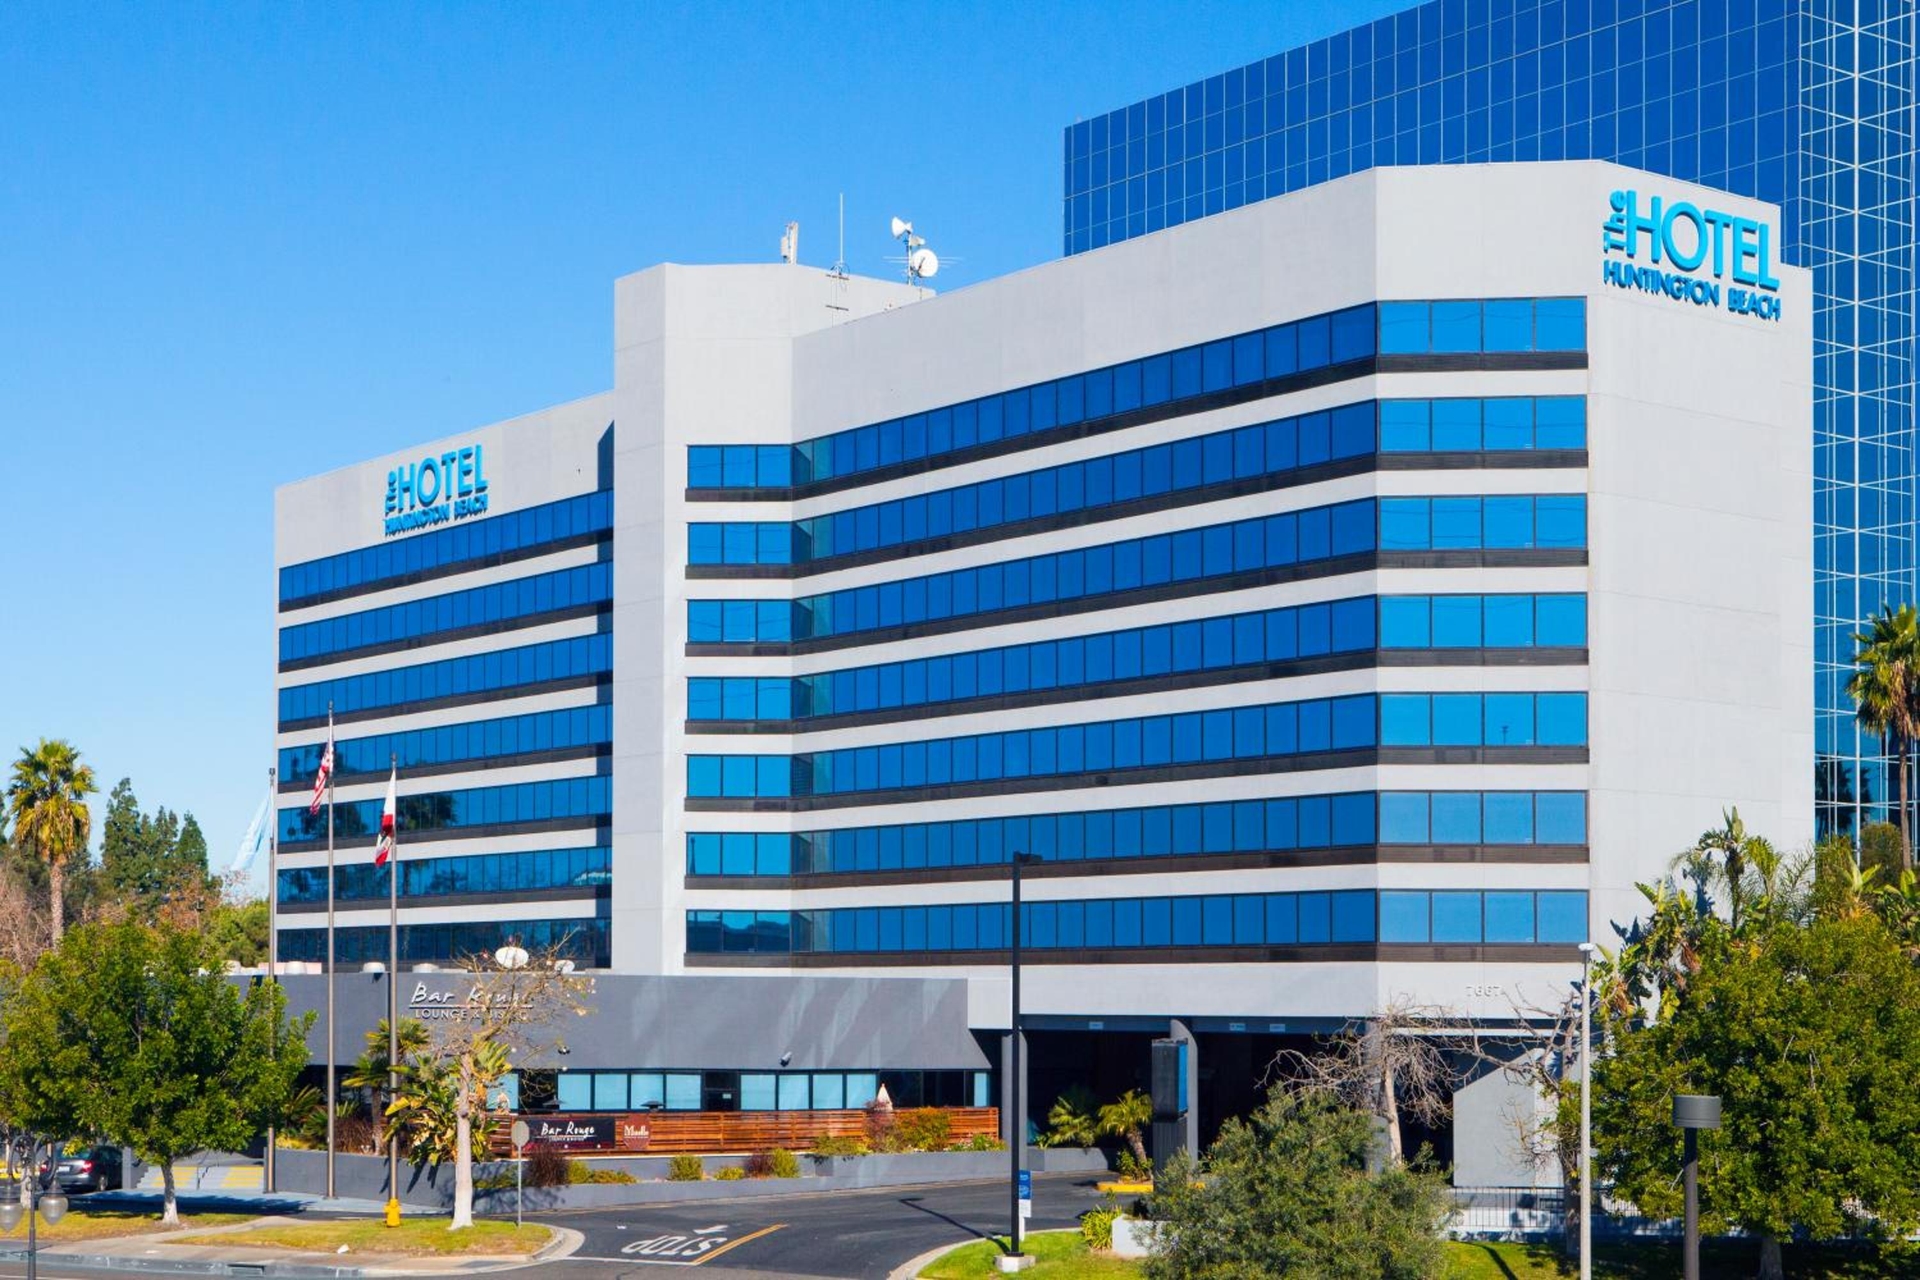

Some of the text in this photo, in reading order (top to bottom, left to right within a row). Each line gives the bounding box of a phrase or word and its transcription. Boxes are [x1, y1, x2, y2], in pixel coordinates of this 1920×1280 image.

[1626, 189, 1780, 291] HOTEL
[1603, 260, 1781, 322] HUNTINGTON BEACH
[398, 444, 488, 513] HOTEL
[384, 494, 488, 537] HUNTINGTON BEACH
[411, 981, 455, 1004] Bar
[1465, 984, 1501, 998] 7667
[415, 1009, 468, 1020] LOUNGE
[541, 1120, 595, 1138] Bar Rouge
[621, 1234, 728, 1256] STOP
